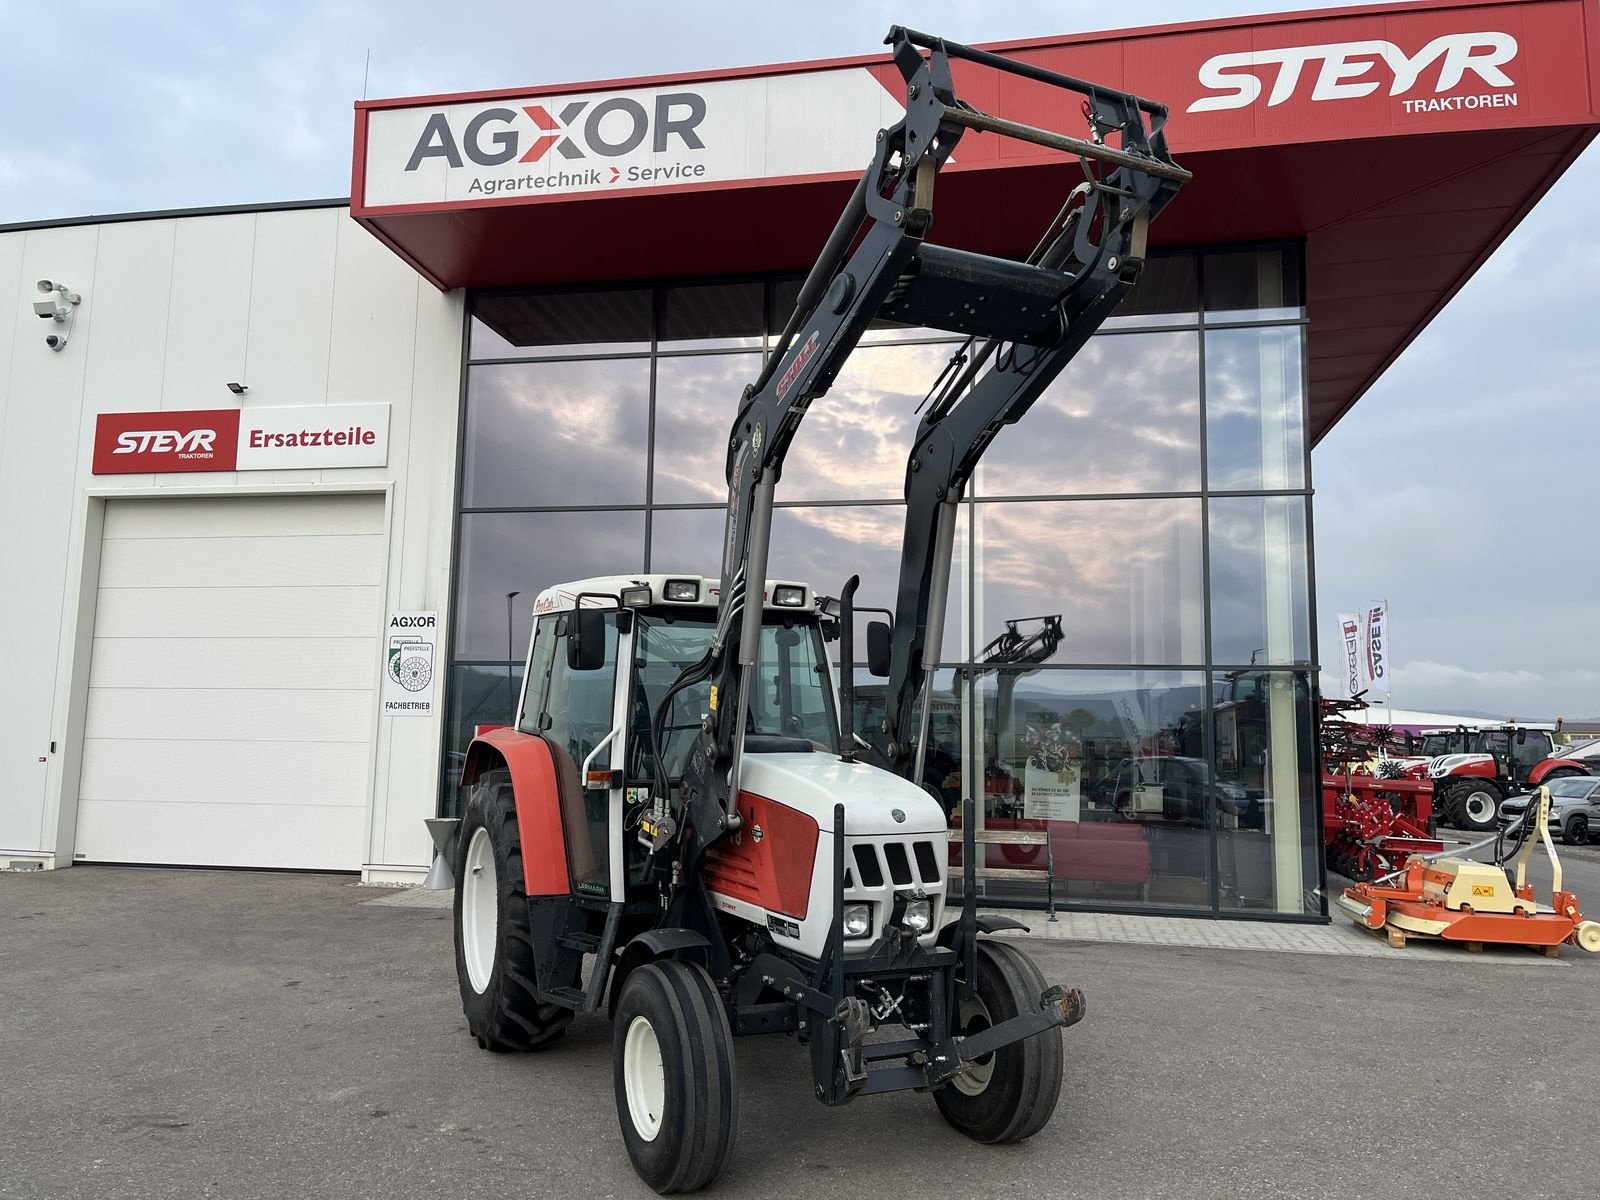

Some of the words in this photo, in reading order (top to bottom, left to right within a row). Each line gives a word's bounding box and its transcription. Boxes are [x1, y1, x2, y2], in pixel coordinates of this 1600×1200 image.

[1186, 31, 1518, 113] STEYR
[1402, 93, 1518, 113] TRAKTOREN
[404, 92, 706, 171] AGXOR
[468, 168, 601, 195] Agrartechnik
[626, 162, 706, 182] Service
[112, 429, 217, 454] STEYR
[249, 426, 376, 448] Ersatzteile
[390, 617, 435, 627] AGXOR
[385, 701, 431, 710] FACHBETRIEB
